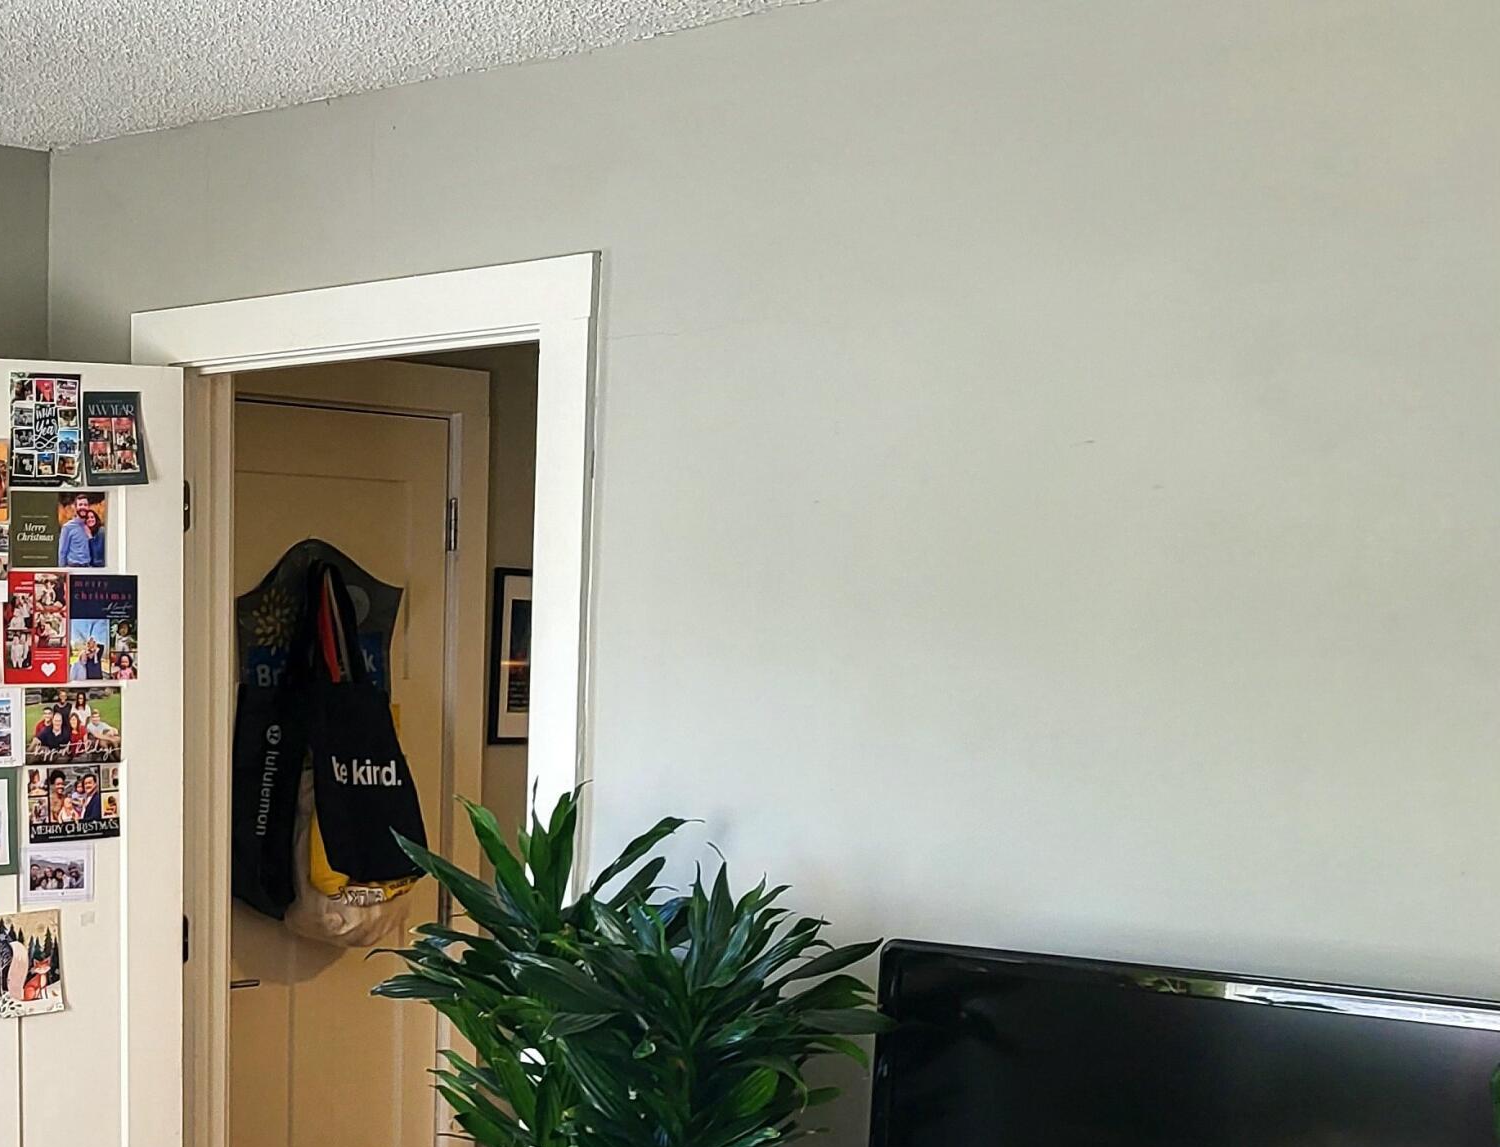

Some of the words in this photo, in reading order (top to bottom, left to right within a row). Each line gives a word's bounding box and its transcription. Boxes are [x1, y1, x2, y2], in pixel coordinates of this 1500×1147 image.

[110, 403, 135, 416] YEAR
[23, 523, 47, 534] Merry
[16, 532, 54, 542] Christmas
[74, 580, 109, 588] merry
[74, 592, 132, 600] christmas
[255, 750, 281, 837] lululemon
[31, 822, 64, 836] MERRY
[65, 818, 120, 834] CHRISTMAS
